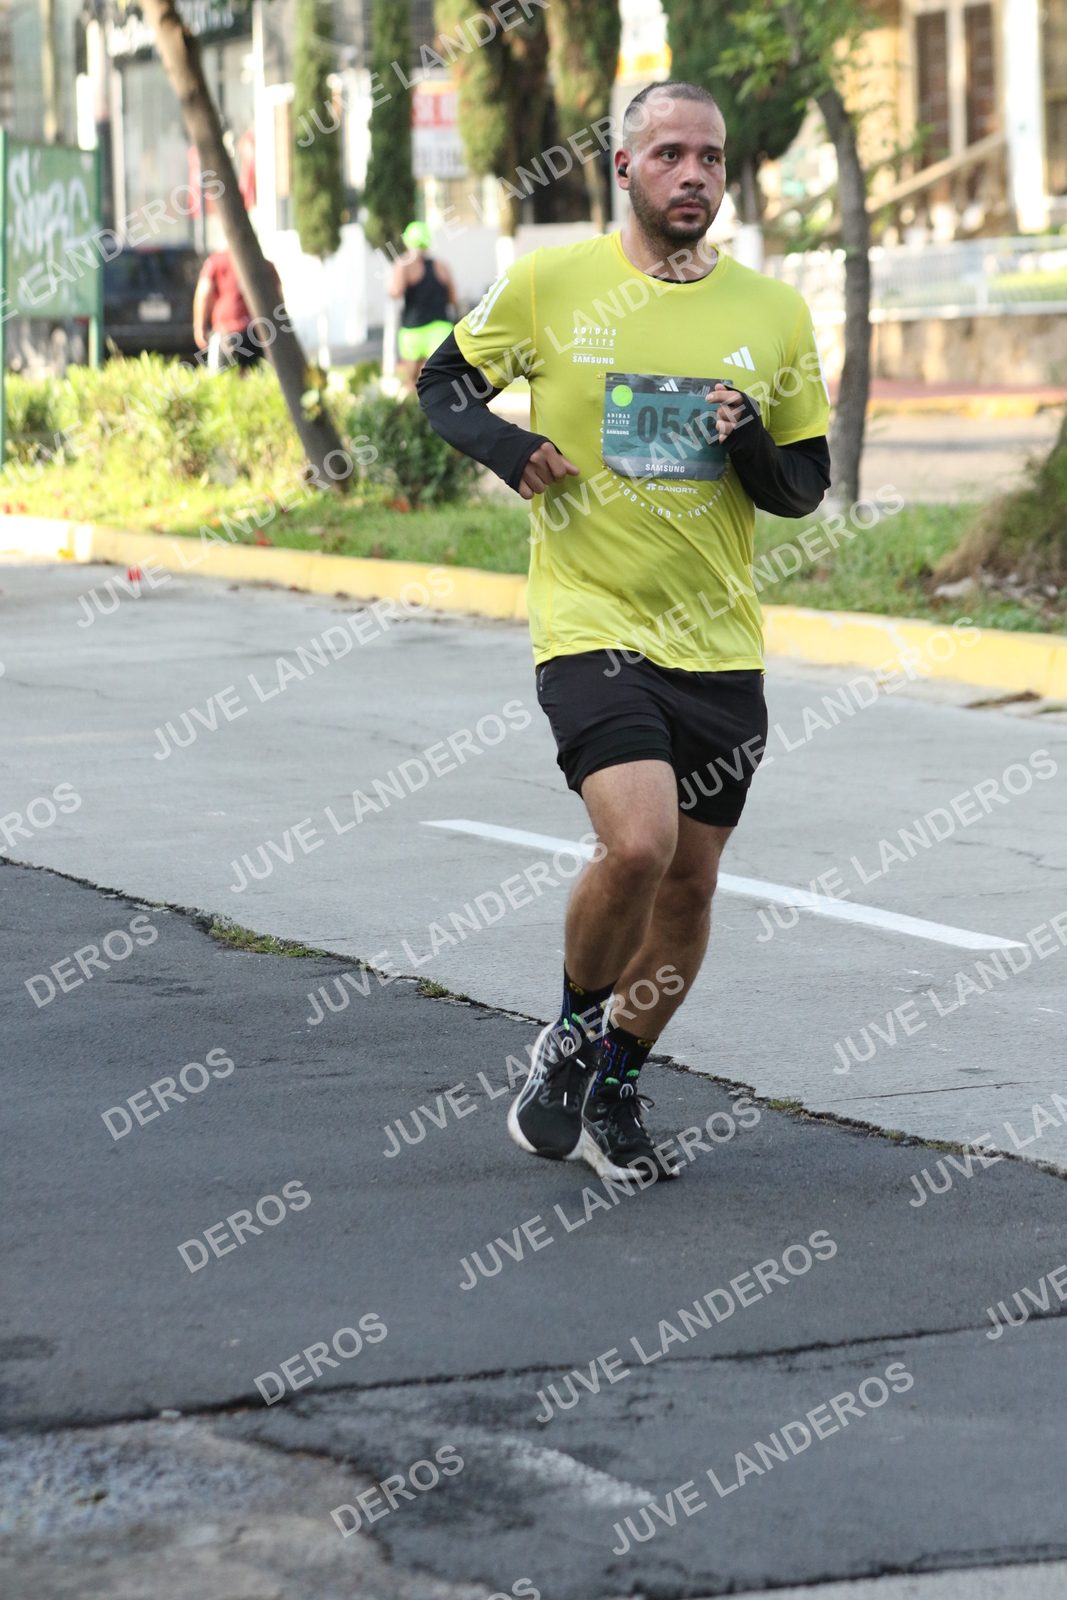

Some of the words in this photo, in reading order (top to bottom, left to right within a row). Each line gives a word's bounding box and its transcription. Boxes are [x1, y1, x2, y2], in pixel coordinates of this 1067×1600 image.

[573, 327, 617, 336] ADIDAS
[573, 337, 615, 347] SPLITS
[572, 355, 615, 365] SAMSUNG
[645, 463, 686, 473] SAMSUNG
[657, 485, 699, 494] BANORTE
